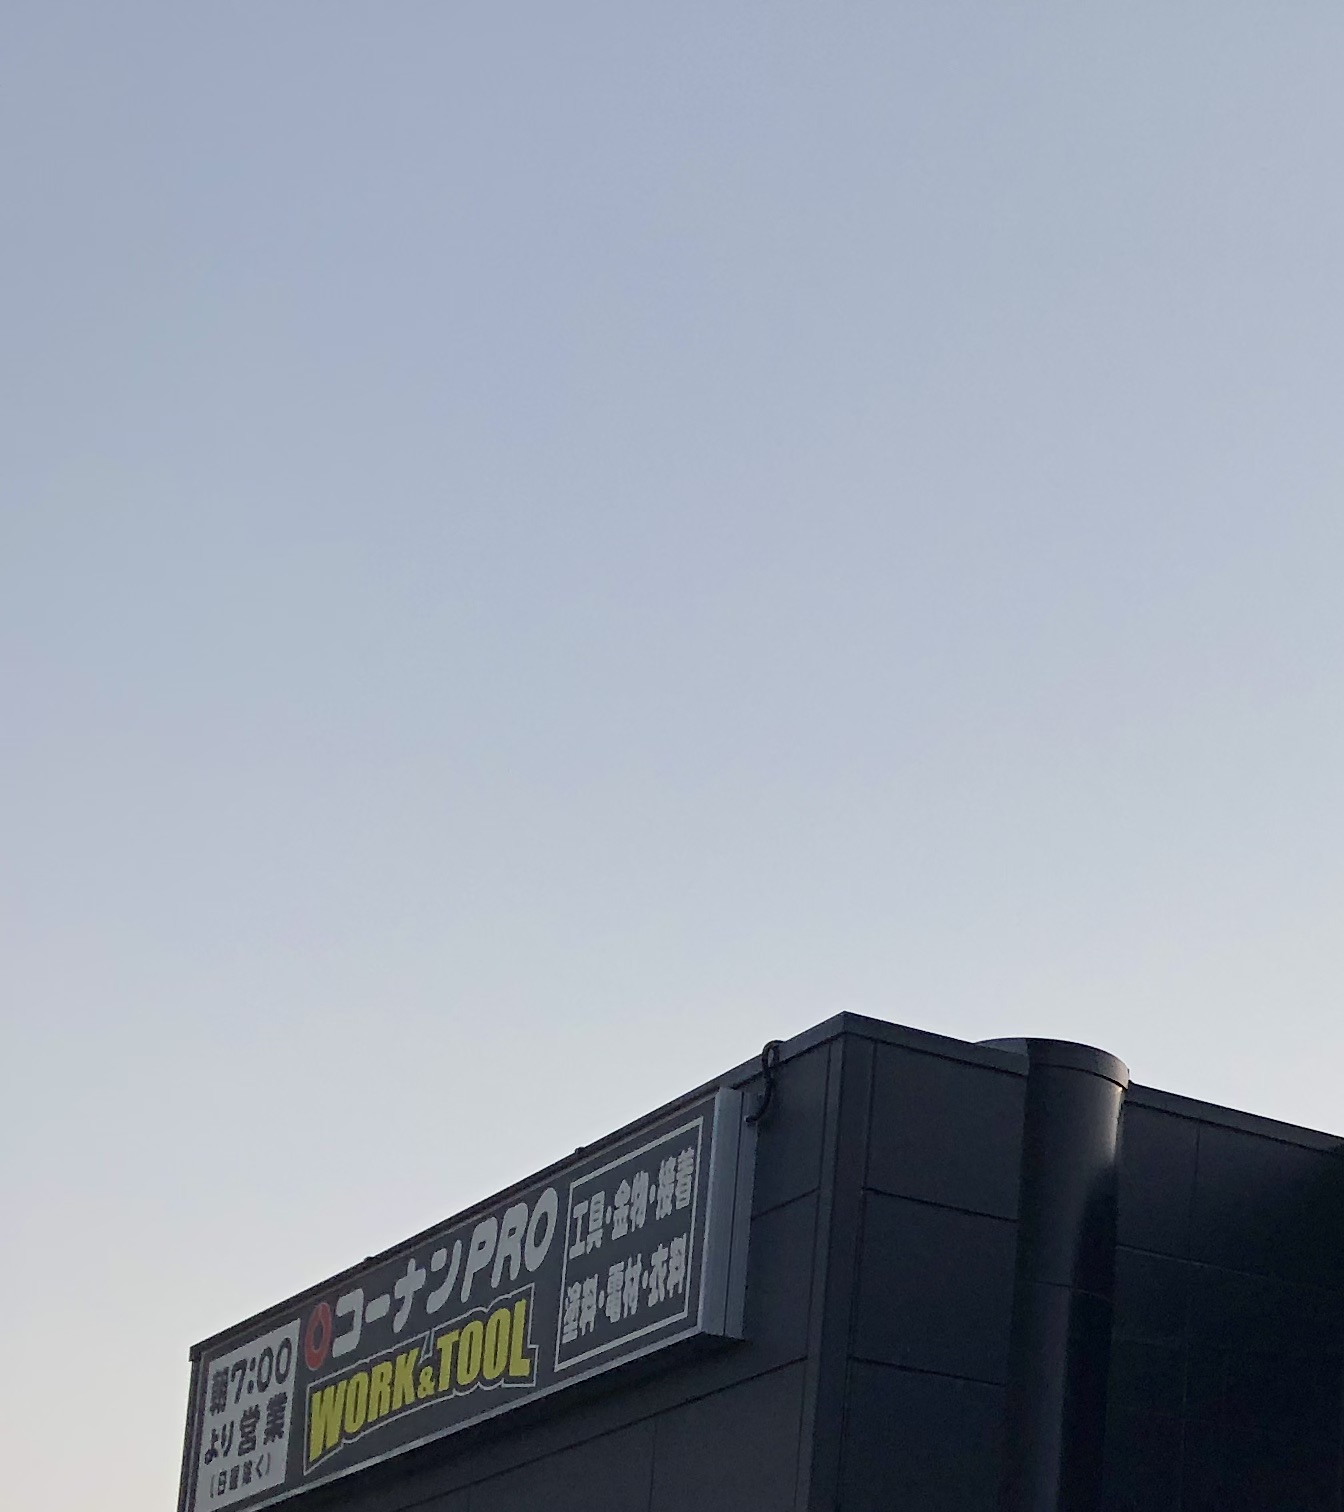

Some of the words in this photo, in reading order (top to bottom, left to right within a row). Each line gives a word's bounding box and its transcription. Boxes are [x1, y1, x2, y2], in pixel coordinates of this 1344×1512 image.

[333, 1187, 558, 1358] コーナンPRO
[309, 1299, 530, 1462] WORK&TOOL
